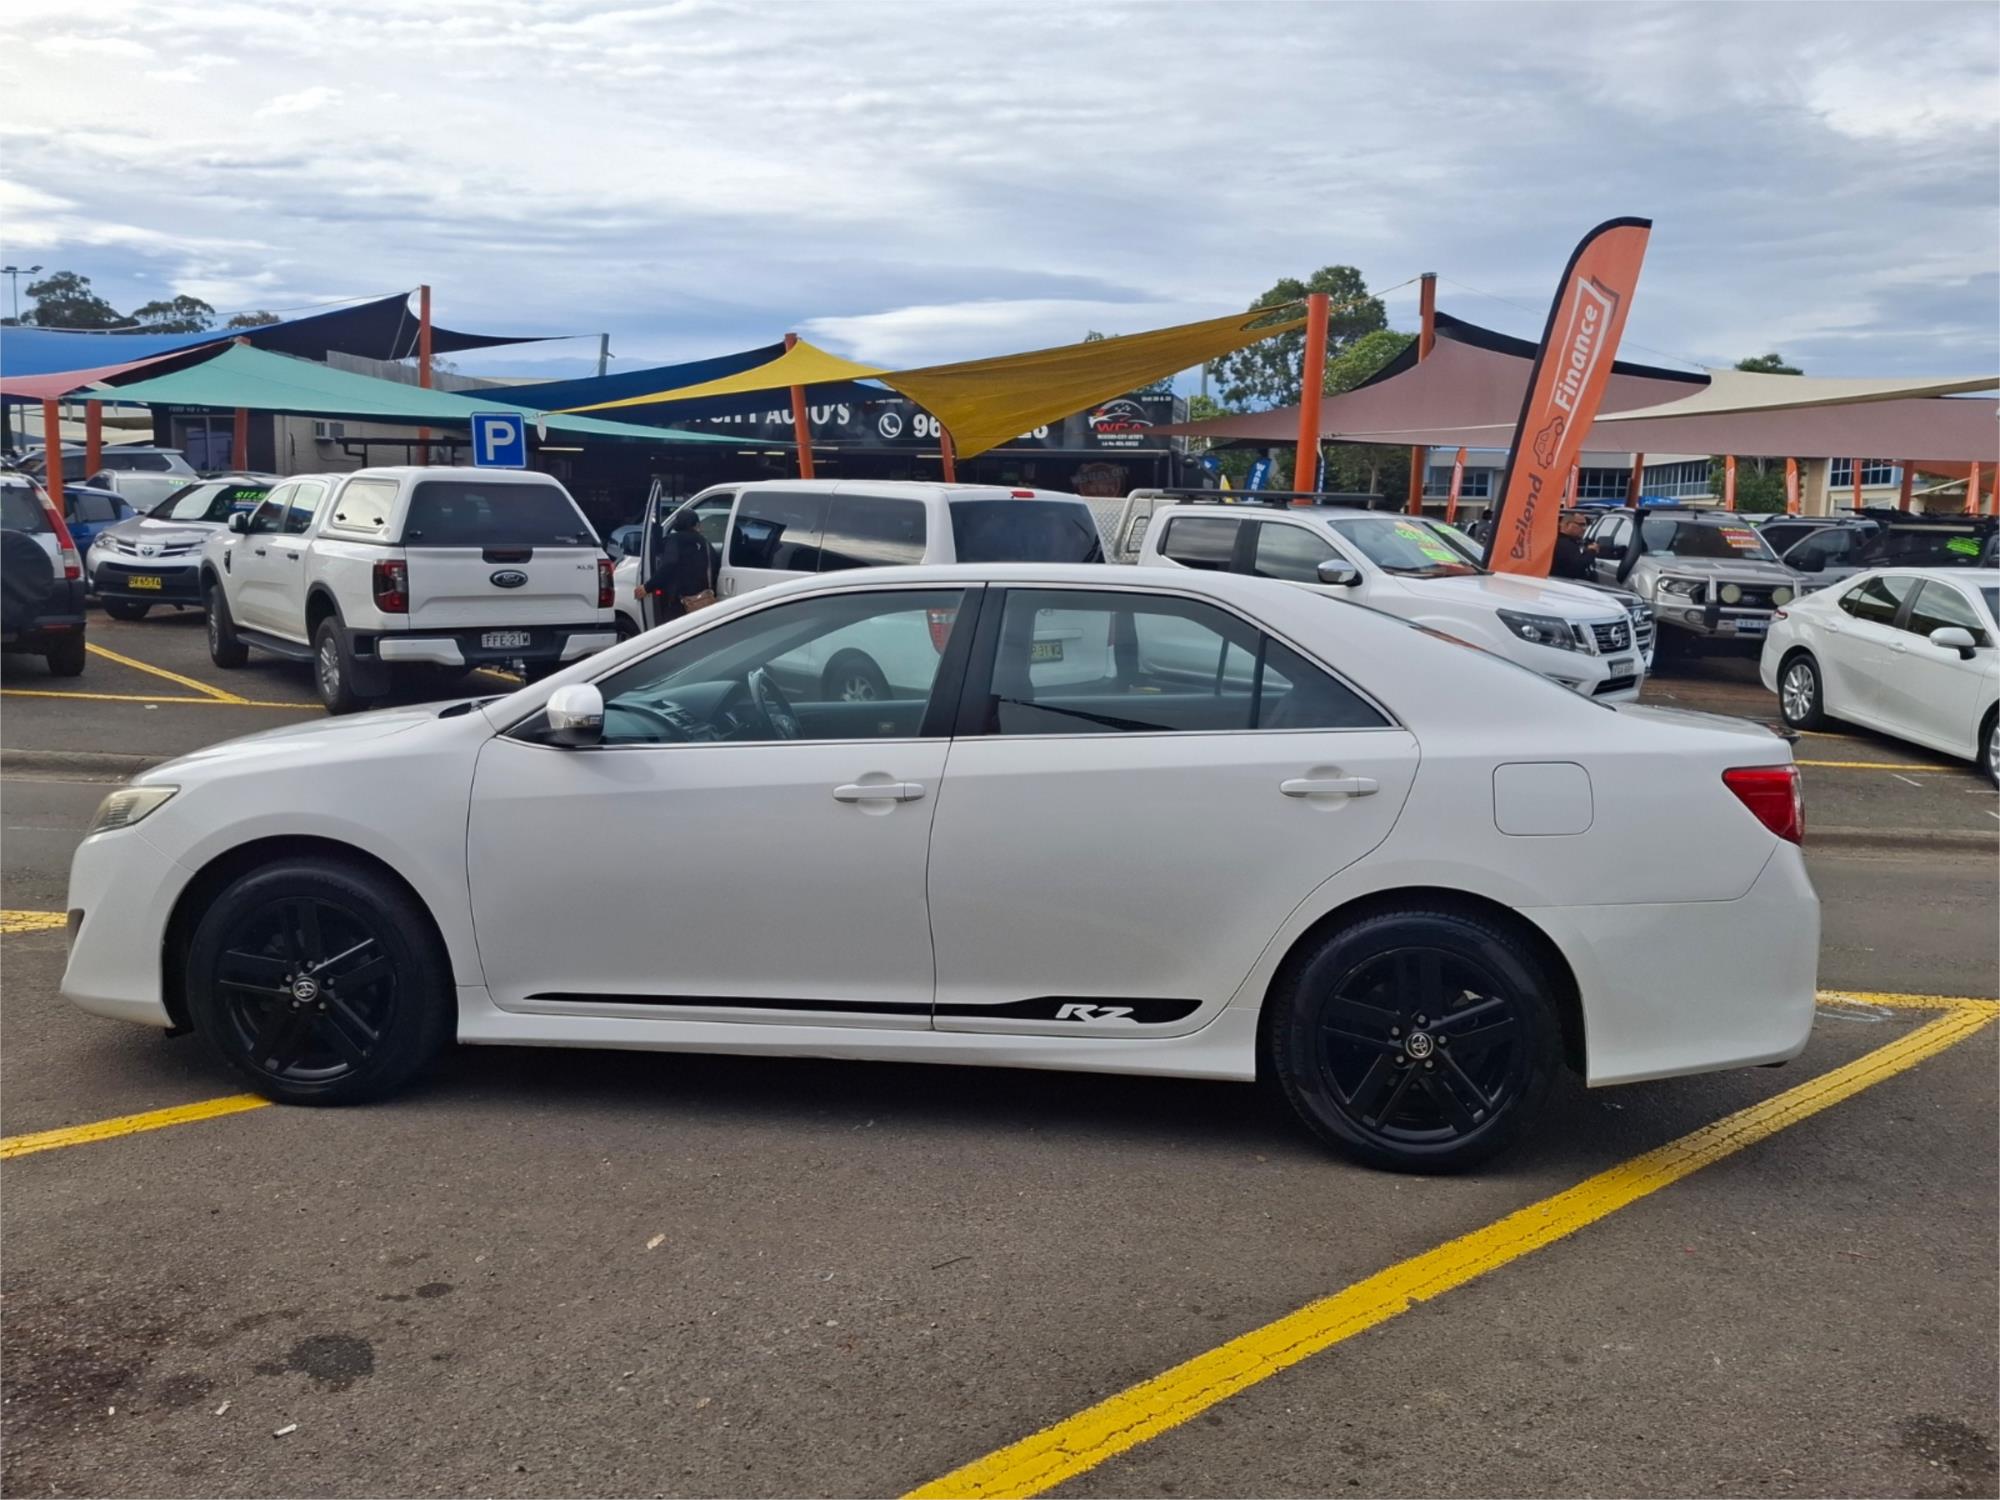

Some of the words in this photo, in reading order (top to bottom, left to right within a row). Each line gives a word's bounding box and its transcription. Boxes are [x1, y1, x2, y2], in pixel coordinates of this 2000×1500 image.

[1554, 304, 1598, 412] Finance
[765, 403, 850, 425] AUO'S
[484, 420, 516, 461] P
